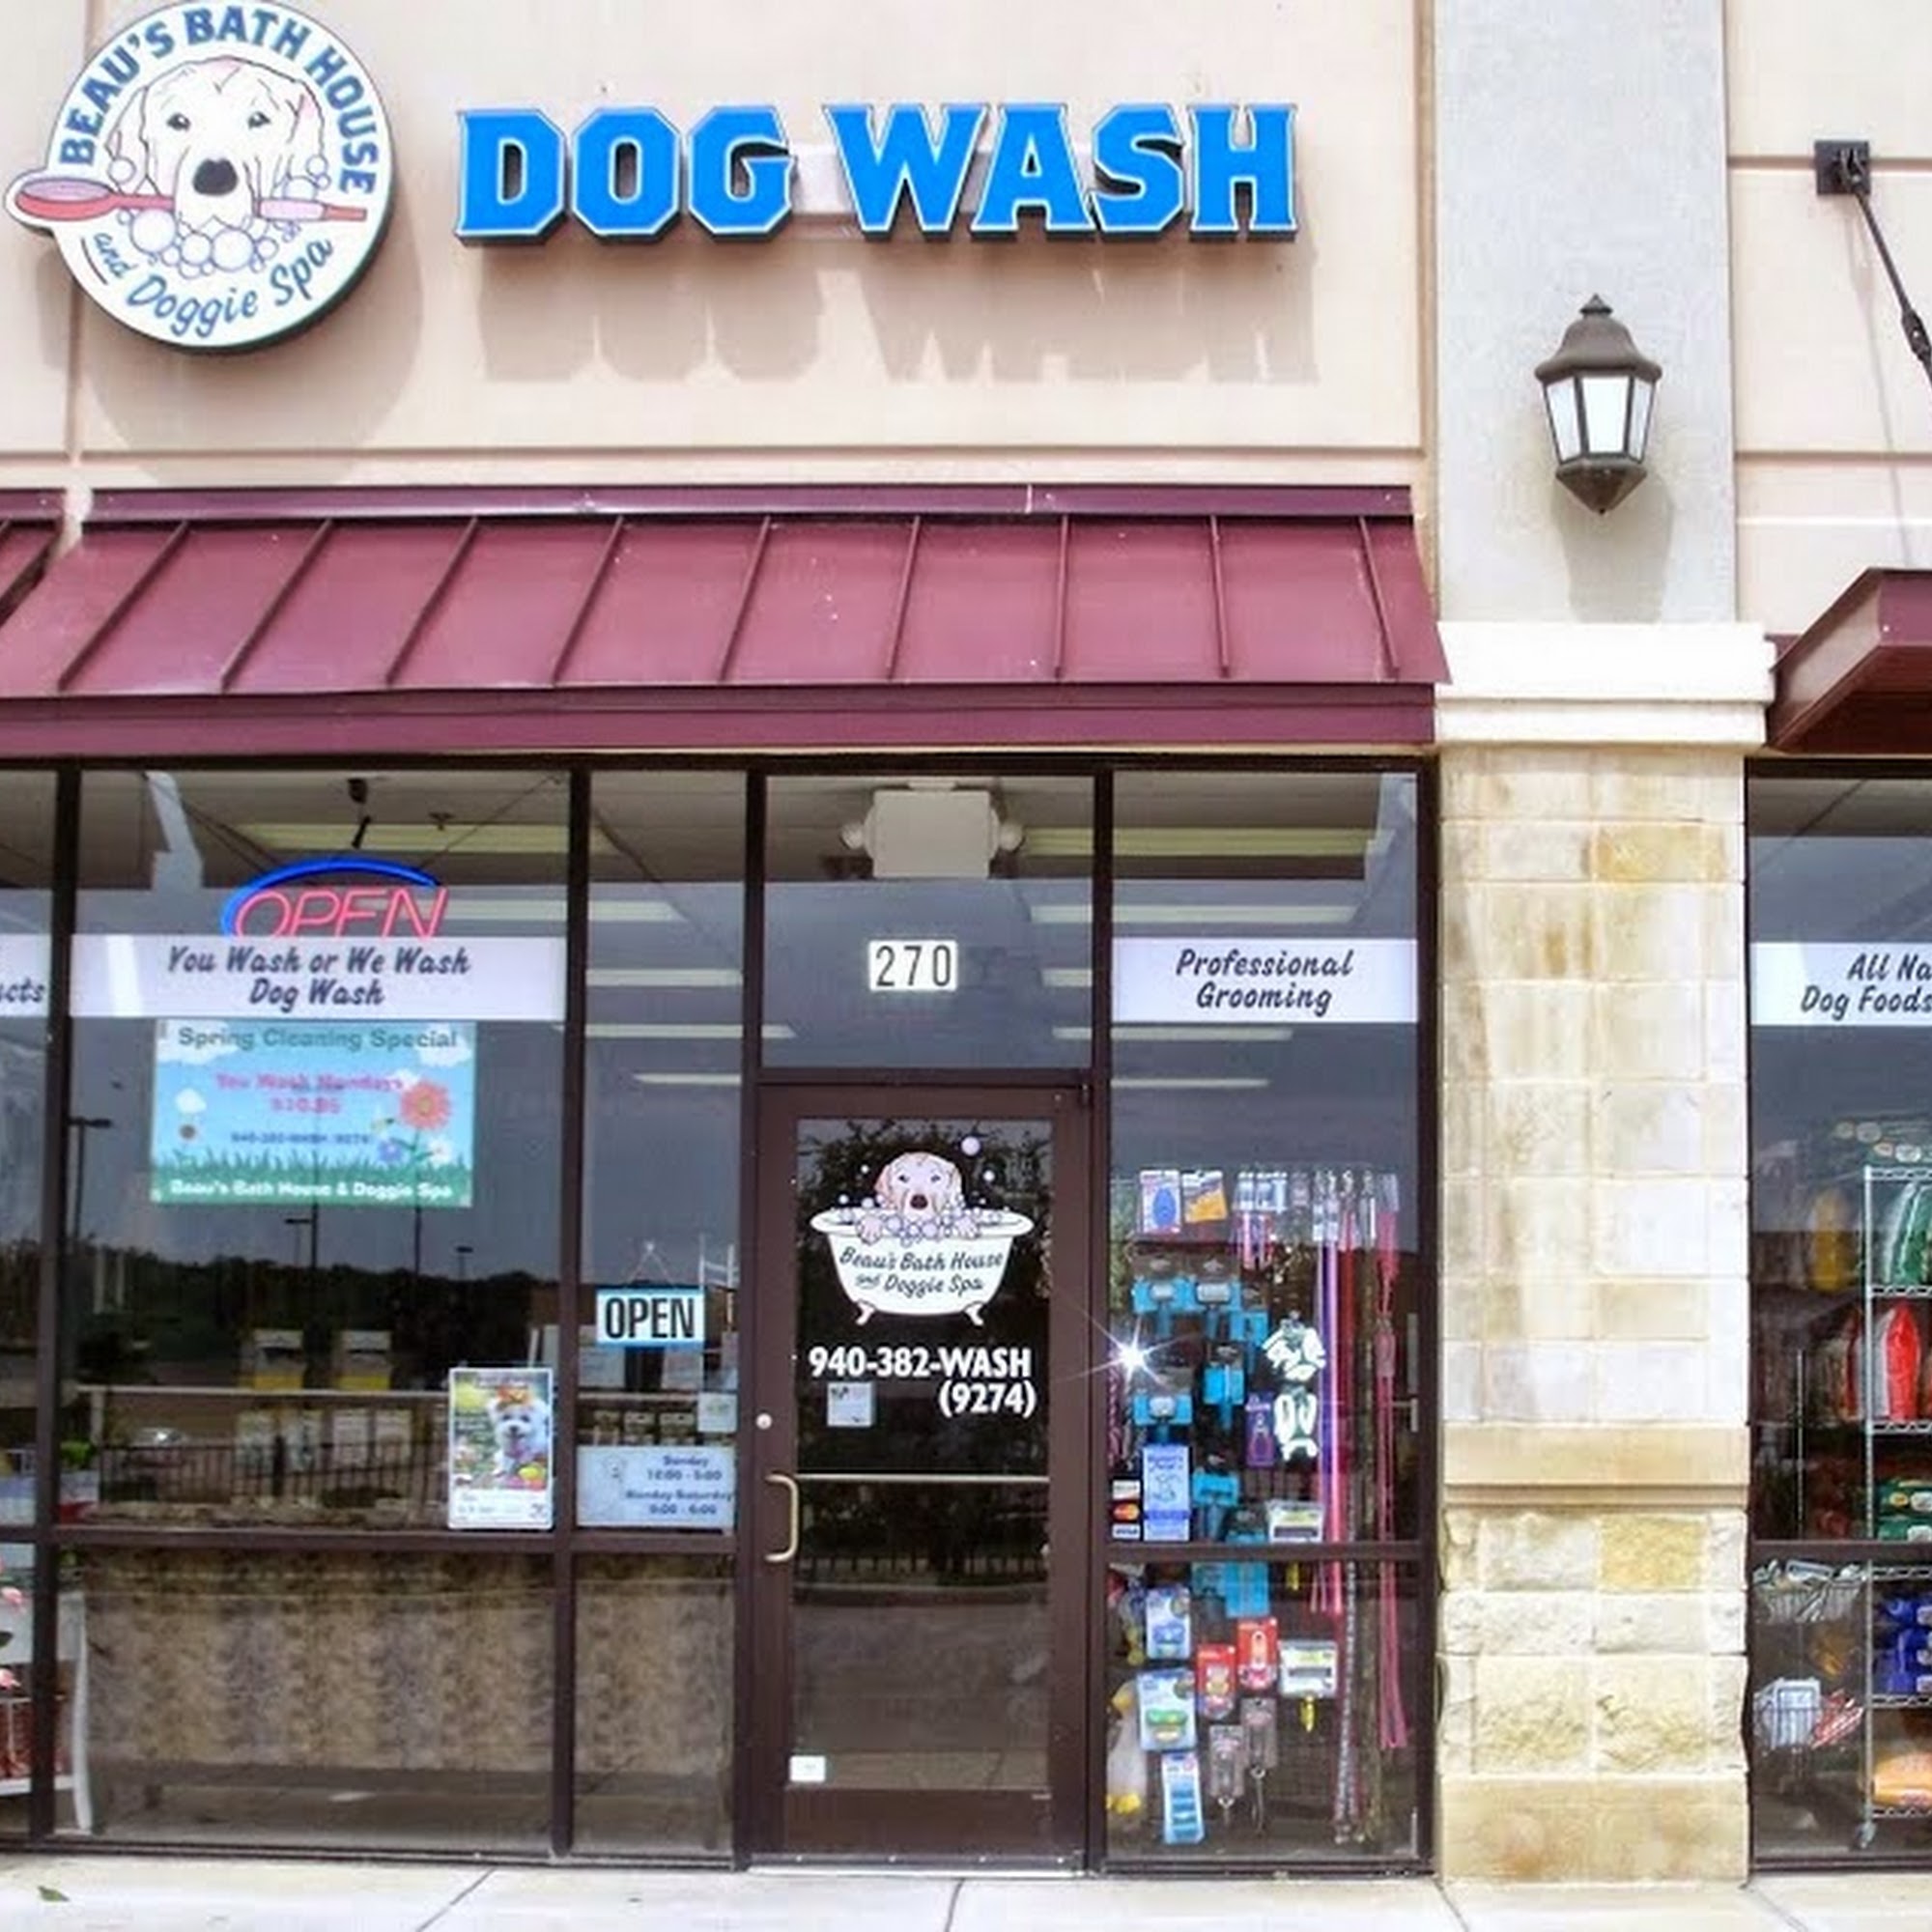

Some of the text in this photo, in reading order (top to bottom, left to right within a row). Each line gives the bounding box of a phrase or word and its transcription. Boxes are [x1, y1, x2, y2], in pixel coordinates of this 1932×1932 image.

[59, 6, 380, 193] BEAU'S BATH HOUSE
[456, 102, 1299, 245] DOG WASH
[93, 233, 333, 338] and Doggie Spa
[167, 945, 470, 974] You Wash or We Wash
[875, 944, 952, 988] 270
[1176, 949, 1353, 978] Professional
[1846, 952, 1890, 980] All
[248, 978, 385, 1012] Dog Wash
[1196, 981, 1331, 1016] Grooming
[1801, 984, 1850, 1021] Dog
[179, 1027, 457, 1050] Spring Cleaning Special
[233, 1179, 274, 1196] Bath
[279, 1180, 331, 1197] House
[353, 1181, 413, 1200] Doggie
[416, 1181, 452, 1200] Spa
[899, 1252, 946, 1271] Bath
[950, 1252, 1004, 1270] House
[884, 1274, 945, 1298] Doggie
[949, 1273, 983, 1296] Spa
[605, 1296, 695, 1340] OPEN
[808, 1347, 1032, 1378] 940-382-WASH
[938, 1379, 1037, 1418] (9274)
